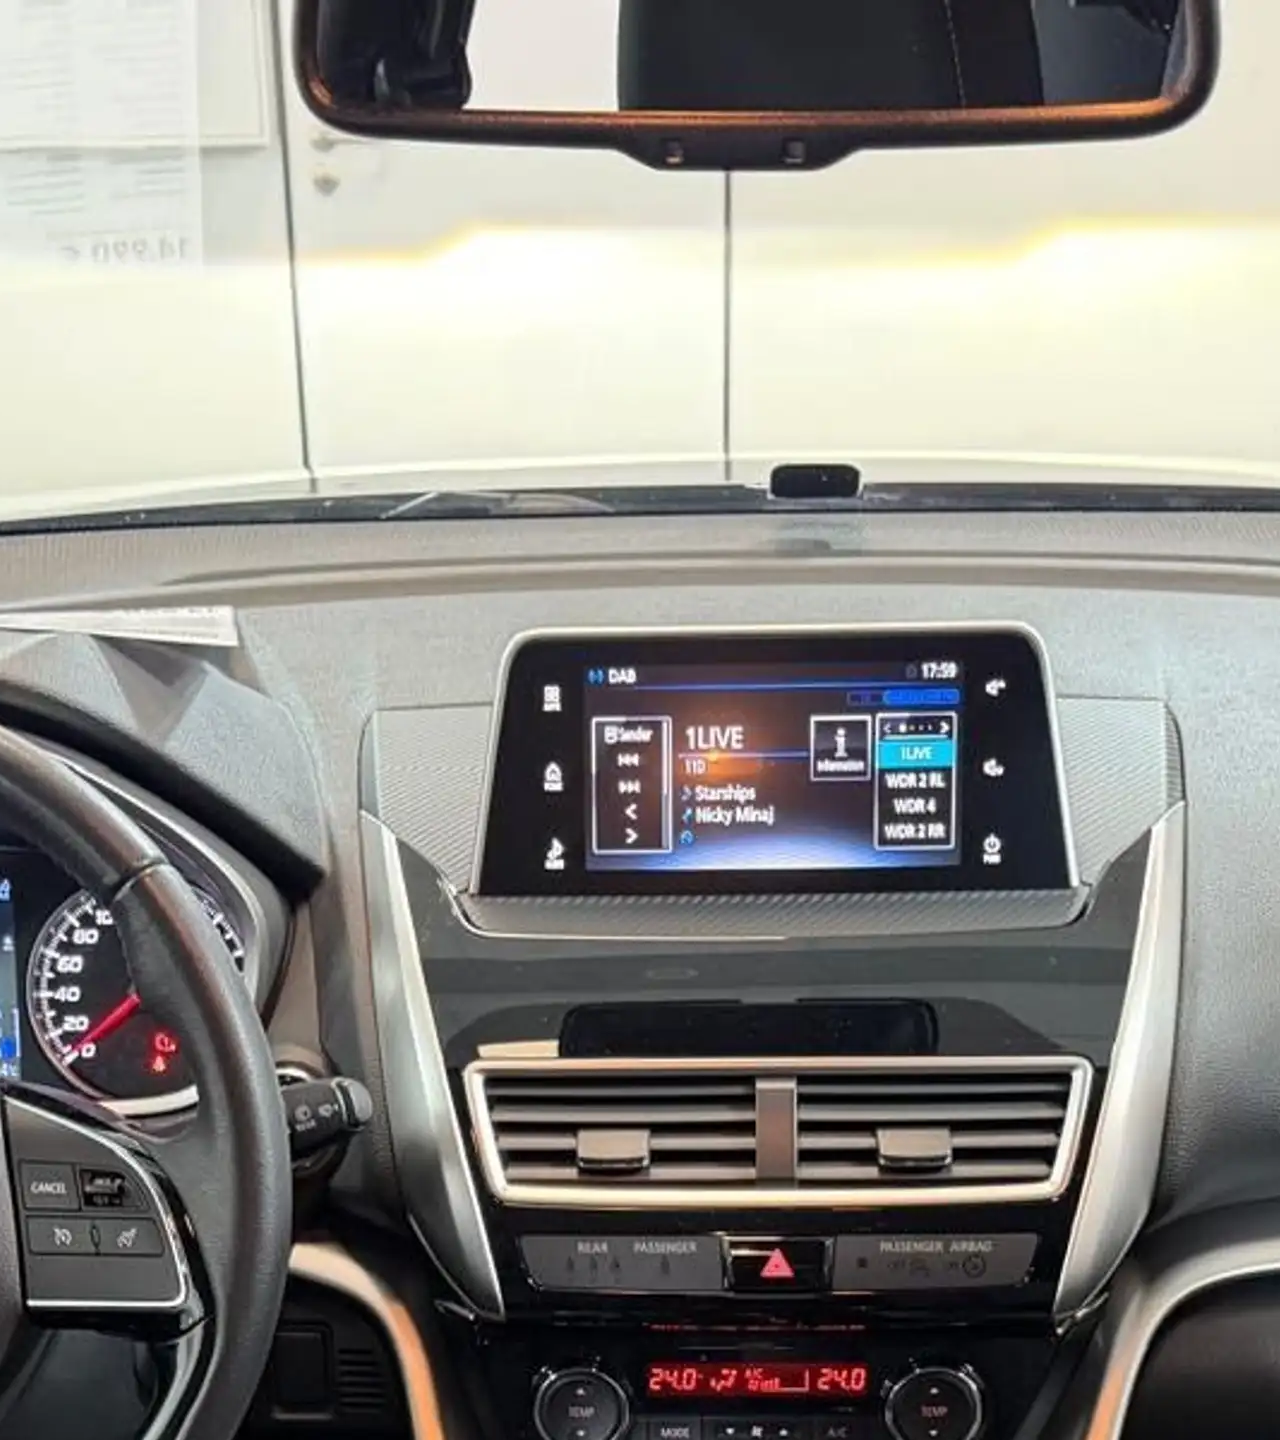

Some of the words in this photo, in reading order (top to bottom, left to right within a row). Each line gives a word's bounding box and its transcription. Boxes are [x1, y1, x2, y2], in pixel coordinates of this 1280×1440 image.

[608, 668, 637, 683] DAB
[921, 661, 956, 679] 17:59
[685, 725, 744, 749] 1LIVE
[901, 745, 933, 761] 1LIVE
[885, 773, 916, 788] WDR
[918, 773, 926, 787] 2
[694, 784, 756, 804] Starships
[893, 798, 923, 814] WDR
[695, 805, 731, 826] Nicky
[735, 804, 775, 825] Minaj
[883, 823, 917, 840] WDR
[918, 823, 926, 838] 2
[72, 928, 100, 945] 80
[56, 955, 83, 973] 60
[54, 986, 81, 1002] 40
[63, 1015, 90, 1032] 20
[81, 1043, 97, 1058] 0
[30, 1181, 68, 1195] CANCEL
[577, 1241, 609, 1255] REAR
[633, 1240, 698, 1254] PASSENGER
[879, 1239, 944, 1253] PASSENGER
[949, 1239, 994, 1252] AIRBAG
[648, 1367, 697, 1391] 24.0
[817, 1367, 867, 1391] 24.0
[568, 1406, 595, 1418] TEMP
[660, 1427, 690, 1439] MODE
[827, 1426, 849, 1439] A/C
